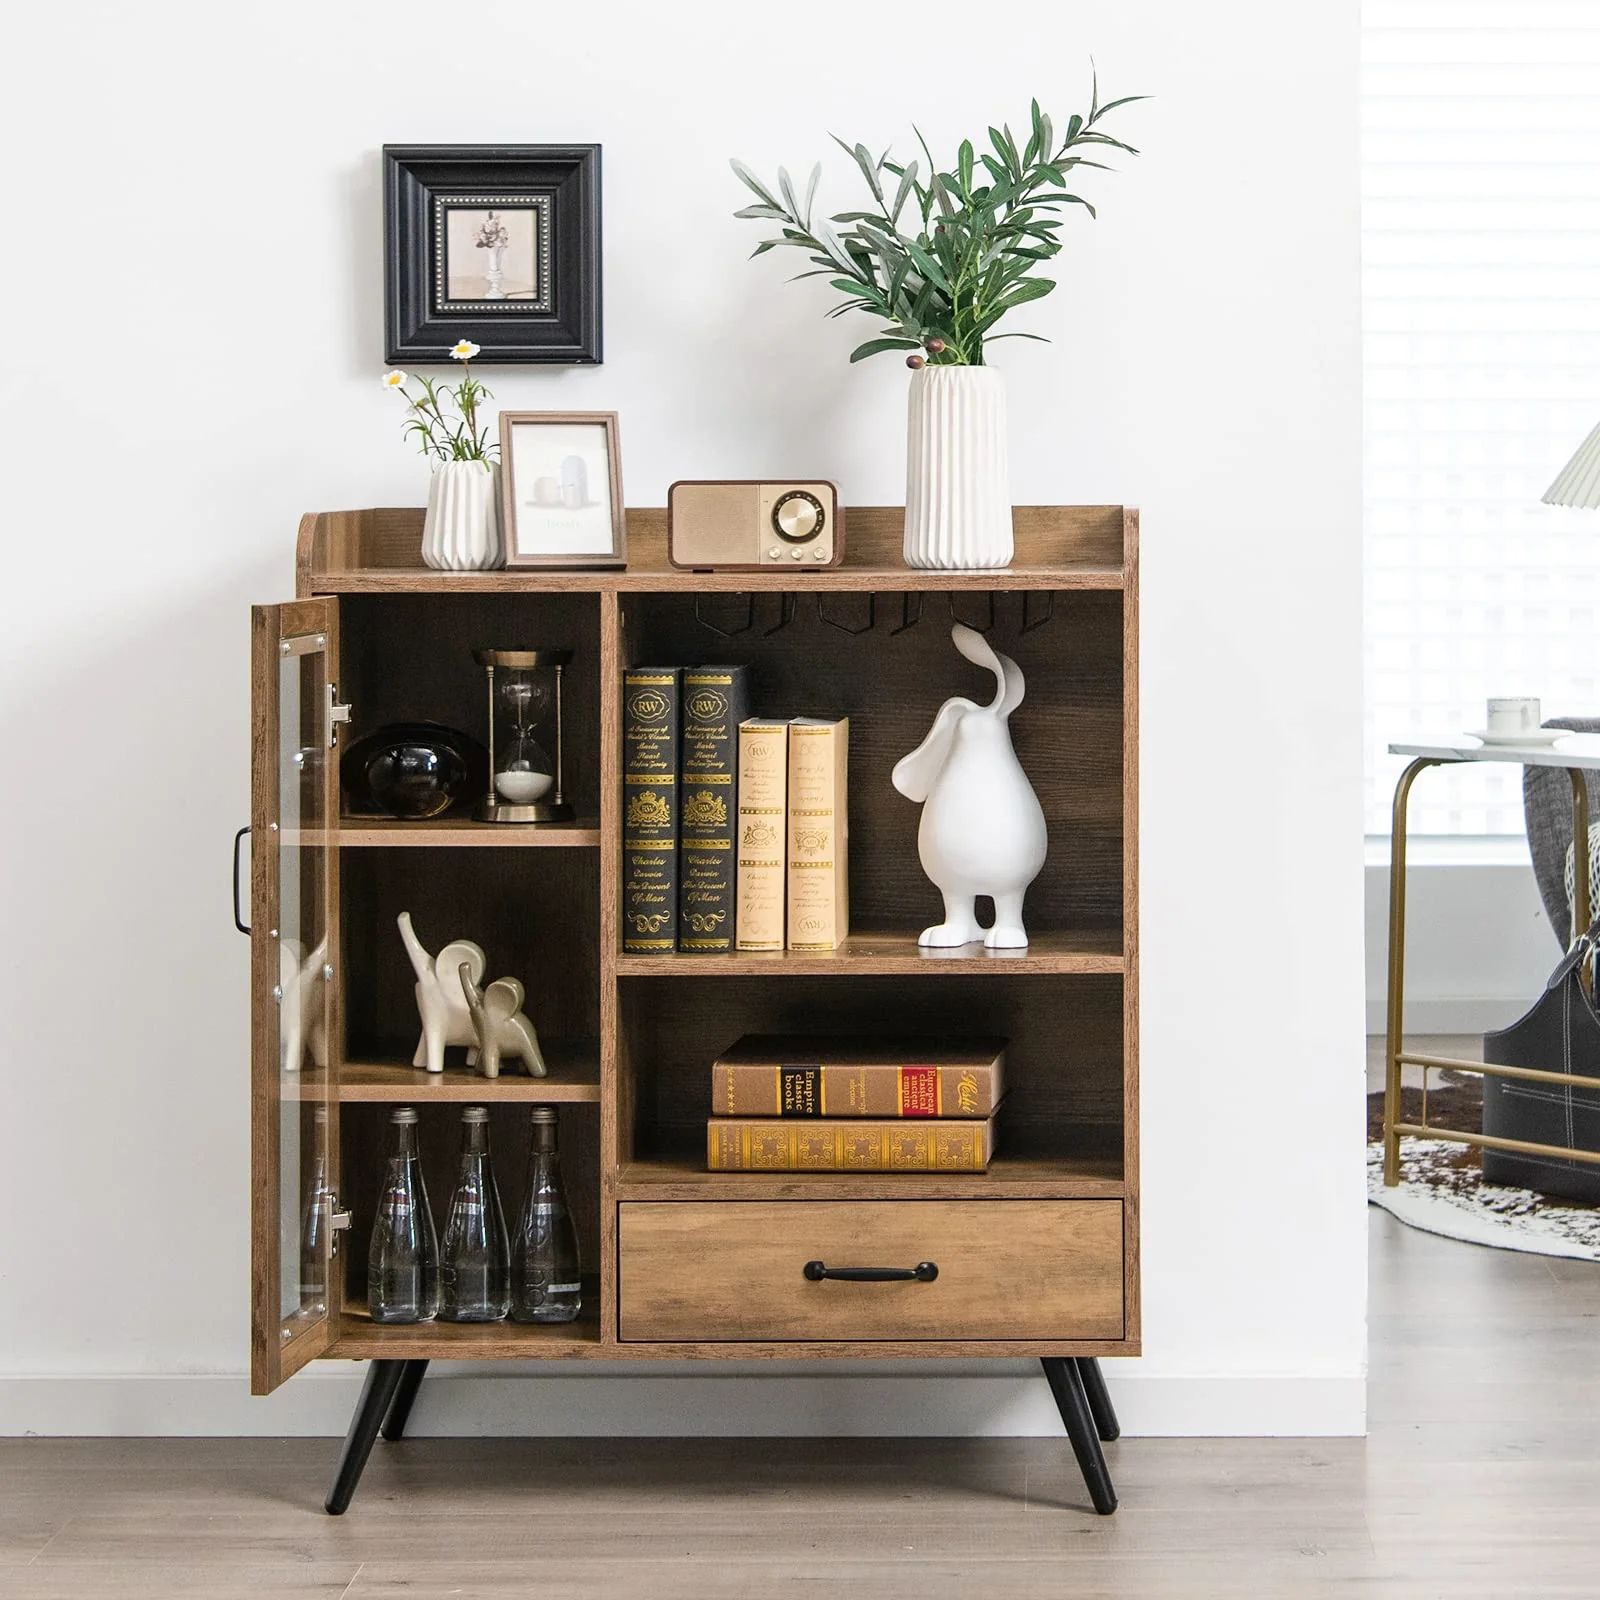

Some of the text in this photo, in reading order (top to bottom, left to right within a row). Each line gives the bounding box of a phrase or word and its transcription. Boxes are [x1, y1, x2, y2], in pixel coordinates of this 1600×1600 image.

[638, 701, 659, 713] RW
[695, 701, 716, 713] RW
[752, 747, 769, 756] RW
[631, 856, 666, 865] Charles
[687, 855, 723, 865] Charles
[785, 1075, 794, 1110] books
[795, 1074, 804, 1110] classic
[804, 1071, 815, 1113] Empire
[903, 1076, 912, 1108] empire
[919, 1073, 928, 1110] classical
[926, 1070, 937, 1114] European
